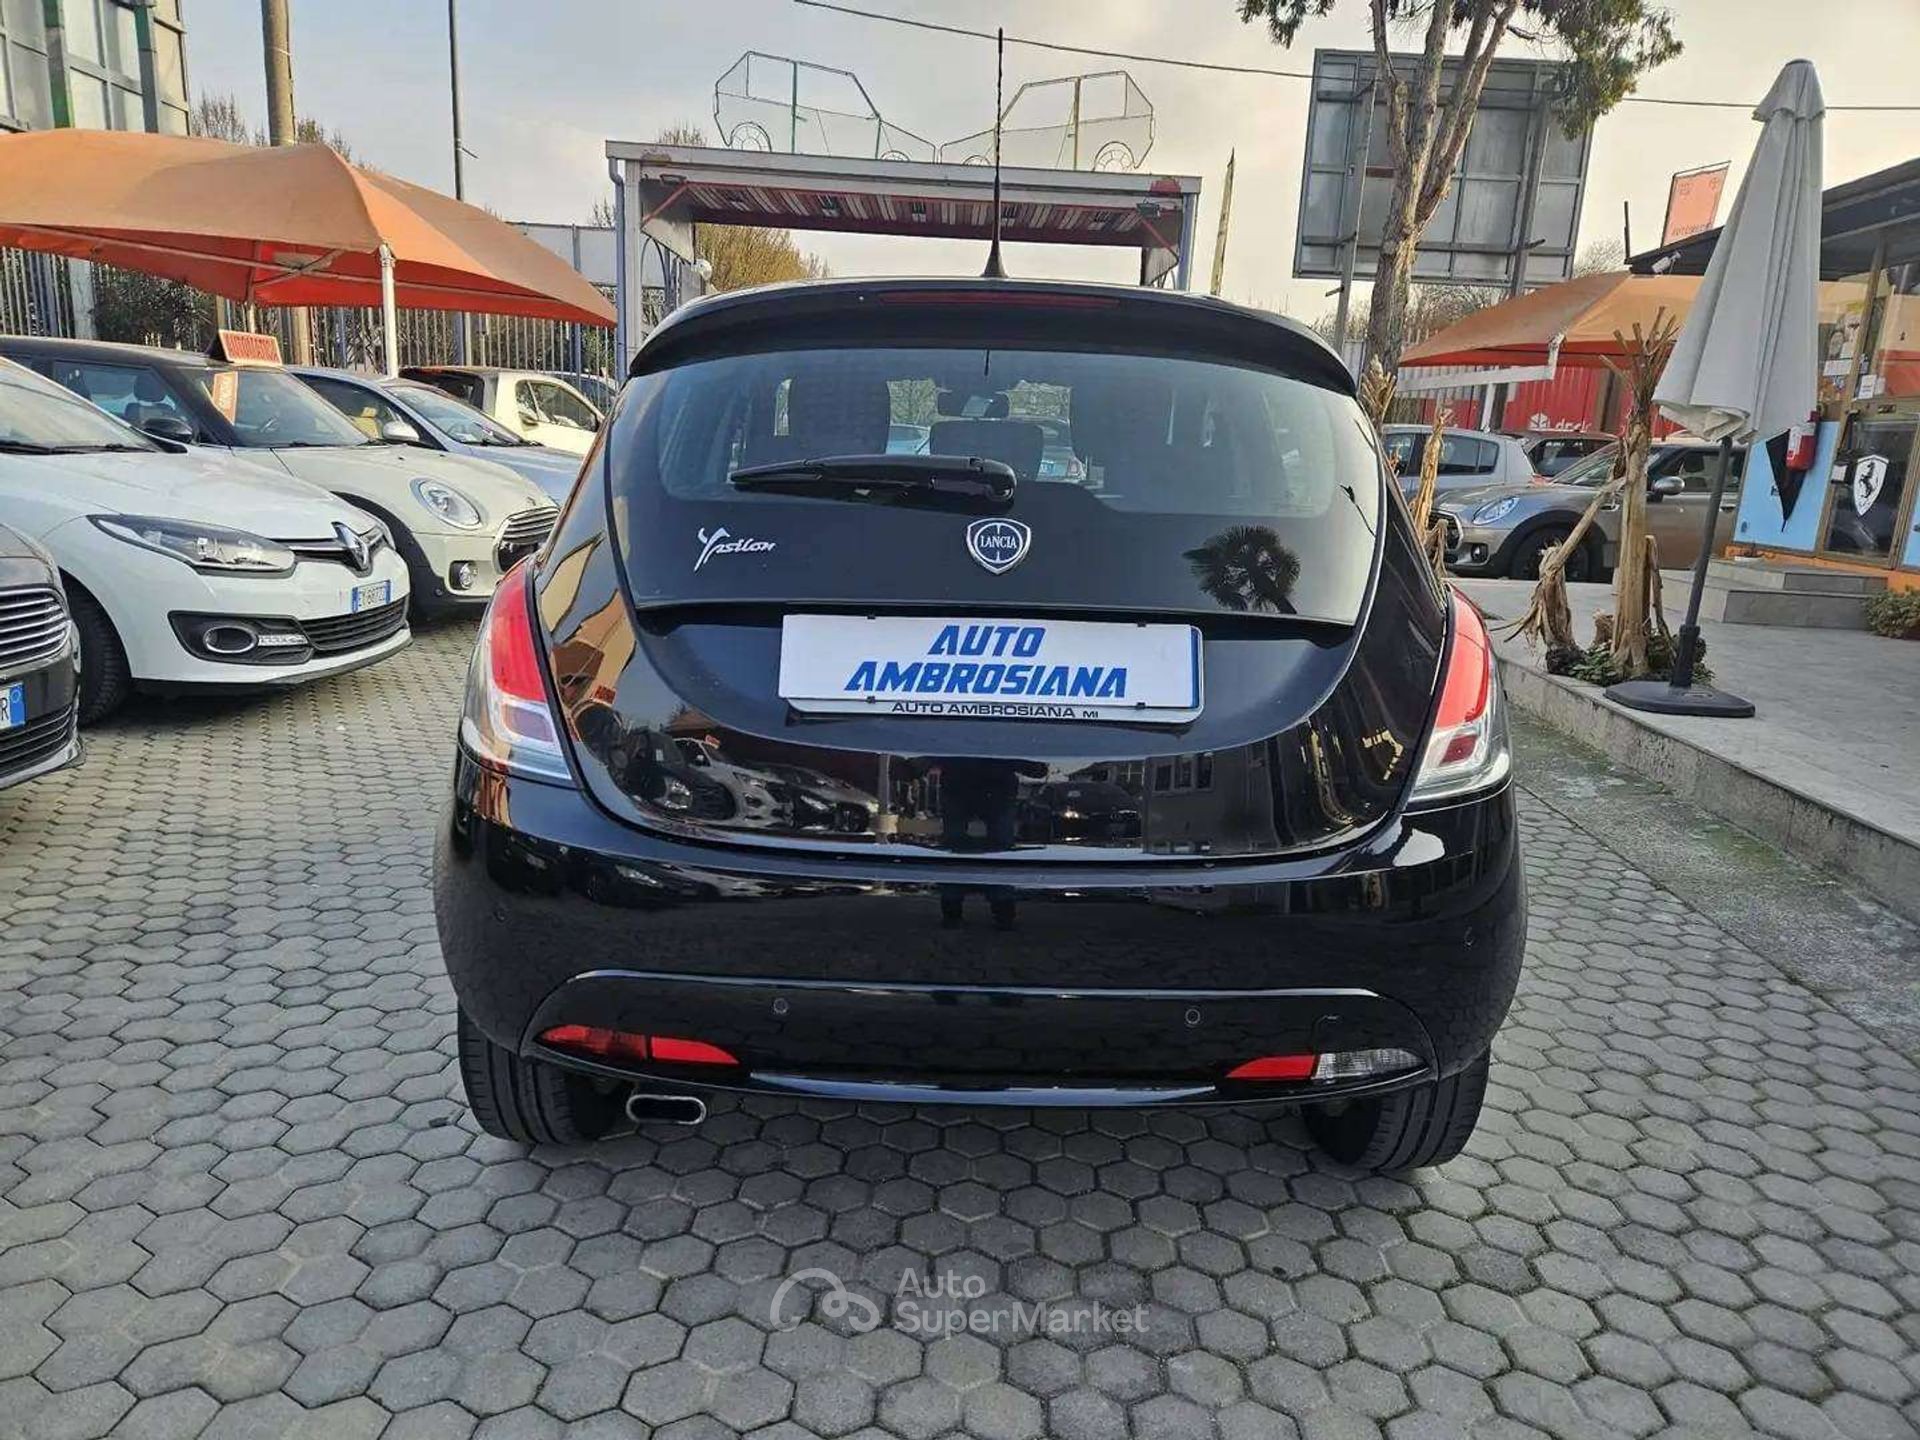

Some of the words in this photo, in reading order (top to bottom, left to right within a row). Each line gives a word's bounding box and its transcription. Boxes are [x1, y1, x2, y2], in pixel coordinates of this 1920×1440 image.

[694, 527, 776, 572] Ypsilon
[980, 535, 1017, 549] LANCIA
[927, 624, 1046, 657] AUTO
[844, 661, 1128, 698] AMBROSIANA
[891, 700, 945, 714] AUTO
[947, 703, 1077, 718] AMBROSIANA
[1082, 710, 1099, 719] MI
